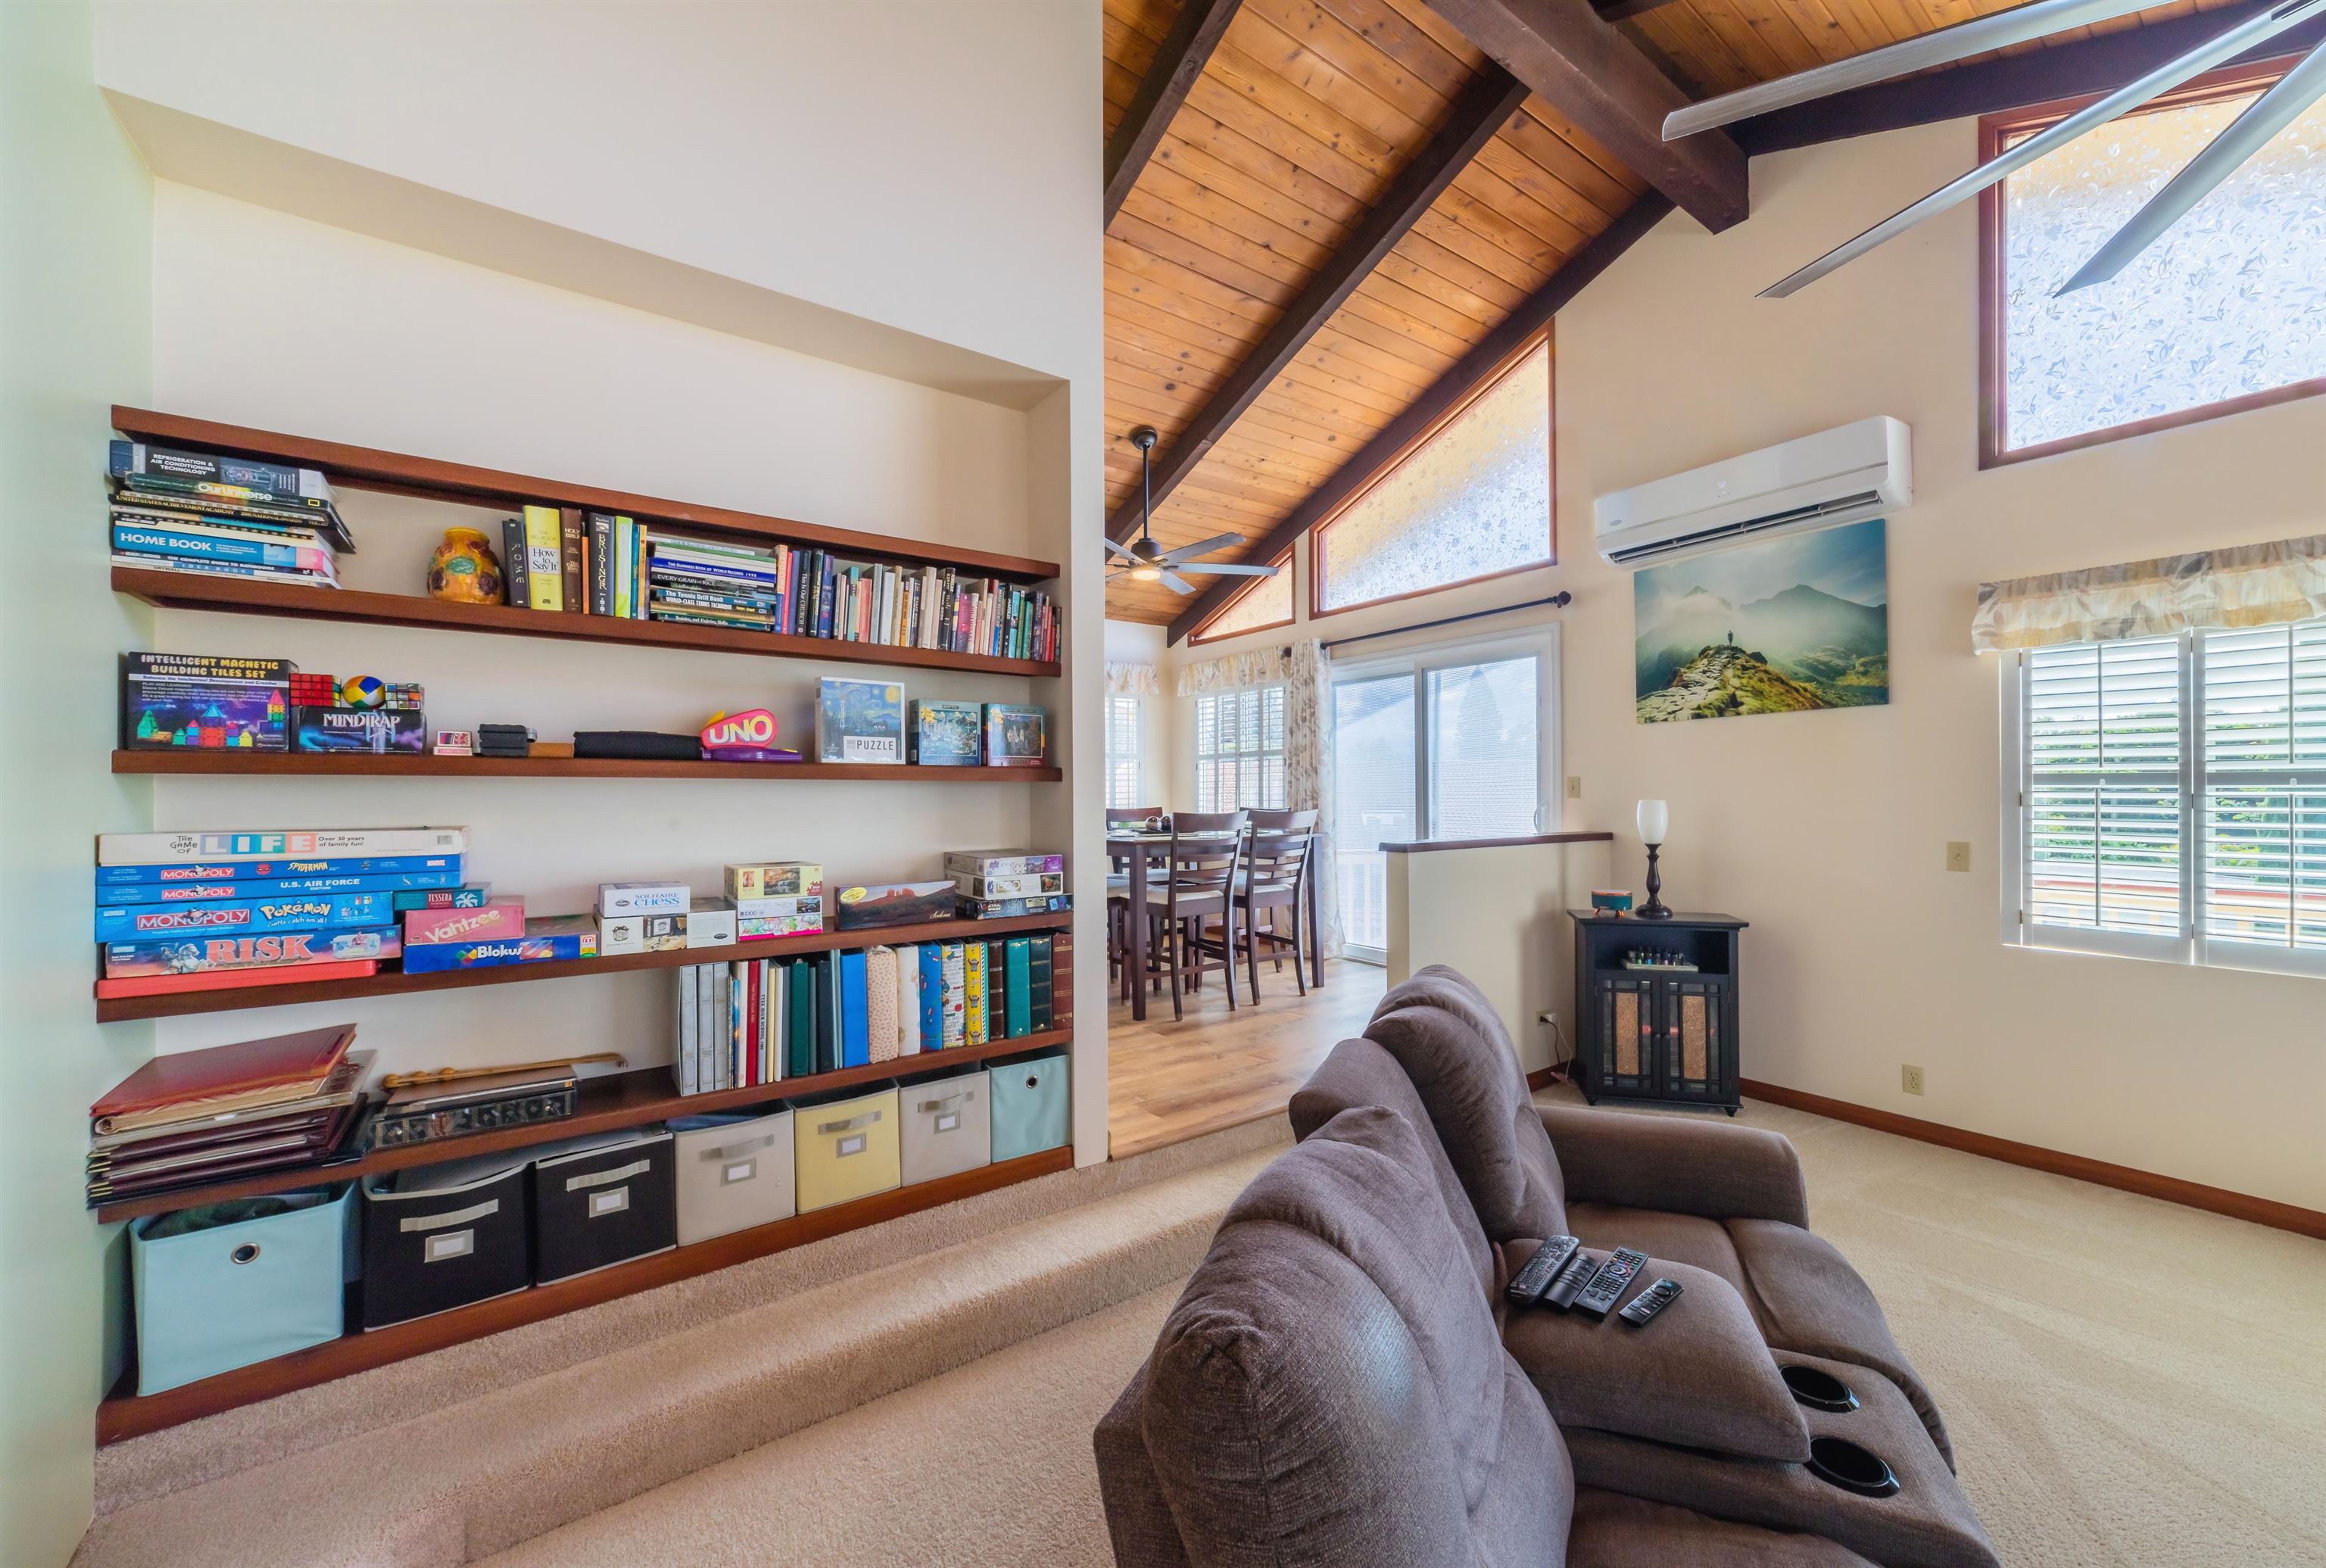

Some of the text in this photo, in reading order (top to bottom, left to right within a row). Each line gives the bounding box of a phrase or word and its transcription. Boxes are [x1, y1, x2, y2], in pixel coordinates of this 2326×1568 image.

[153, 454, 206, 466] REFRIGERATION
[164, 460, 216, 472] CONDITIONING
[160, 464, 207, 475] TECHNOLOGY
[198, 483, 222, 494] Our
[223, 485, 273, 501] Universe
[116, 495, 235, 516] UNITED STATES ACHIEVEMENT ACADEMY
[120, 532, 166, 546] HOME
[169, 538, 212, 551] BOOK
[533, 548, 555, 558] How
[532, 560, 548, 573] Say
[550, 562, 557, 572] It
[598, 534, 606, 591] BRISINGR
[666, 596, 695, 606] WORLD-CLASS
[696, 600, 710, 608] TENNIS
[141, 654, 279, 671] INTELLIGENT MAGNETIC
[151, 665, 267, 679] BUILDING TILES SET
[323, 711, 401, 729] MINDTRAP
[709, 715, 773, 744] UNO
[856, 740, 893, 750] PUZZLE
[204, 834, 312, 853] LIFE
[328, 840, 349, 849] family
[161, 868, 233, 880] MONOPOLY
[281, 878, 360, 889] U.S. AIR FORCE
[164, 888, 233, 899] MONOPOLY
[428, 893, 453, 902] TESSERA
[139, 910, 248, 928] MONOPOLY
[930, 910, 952, 919] Sedona
[267, 918, 287, 927] Gotta
[424, 909, 501, 943] Yahtzee
[204, 934, 314, 963] RISK
[477, 944, 523, 959] Blokus
